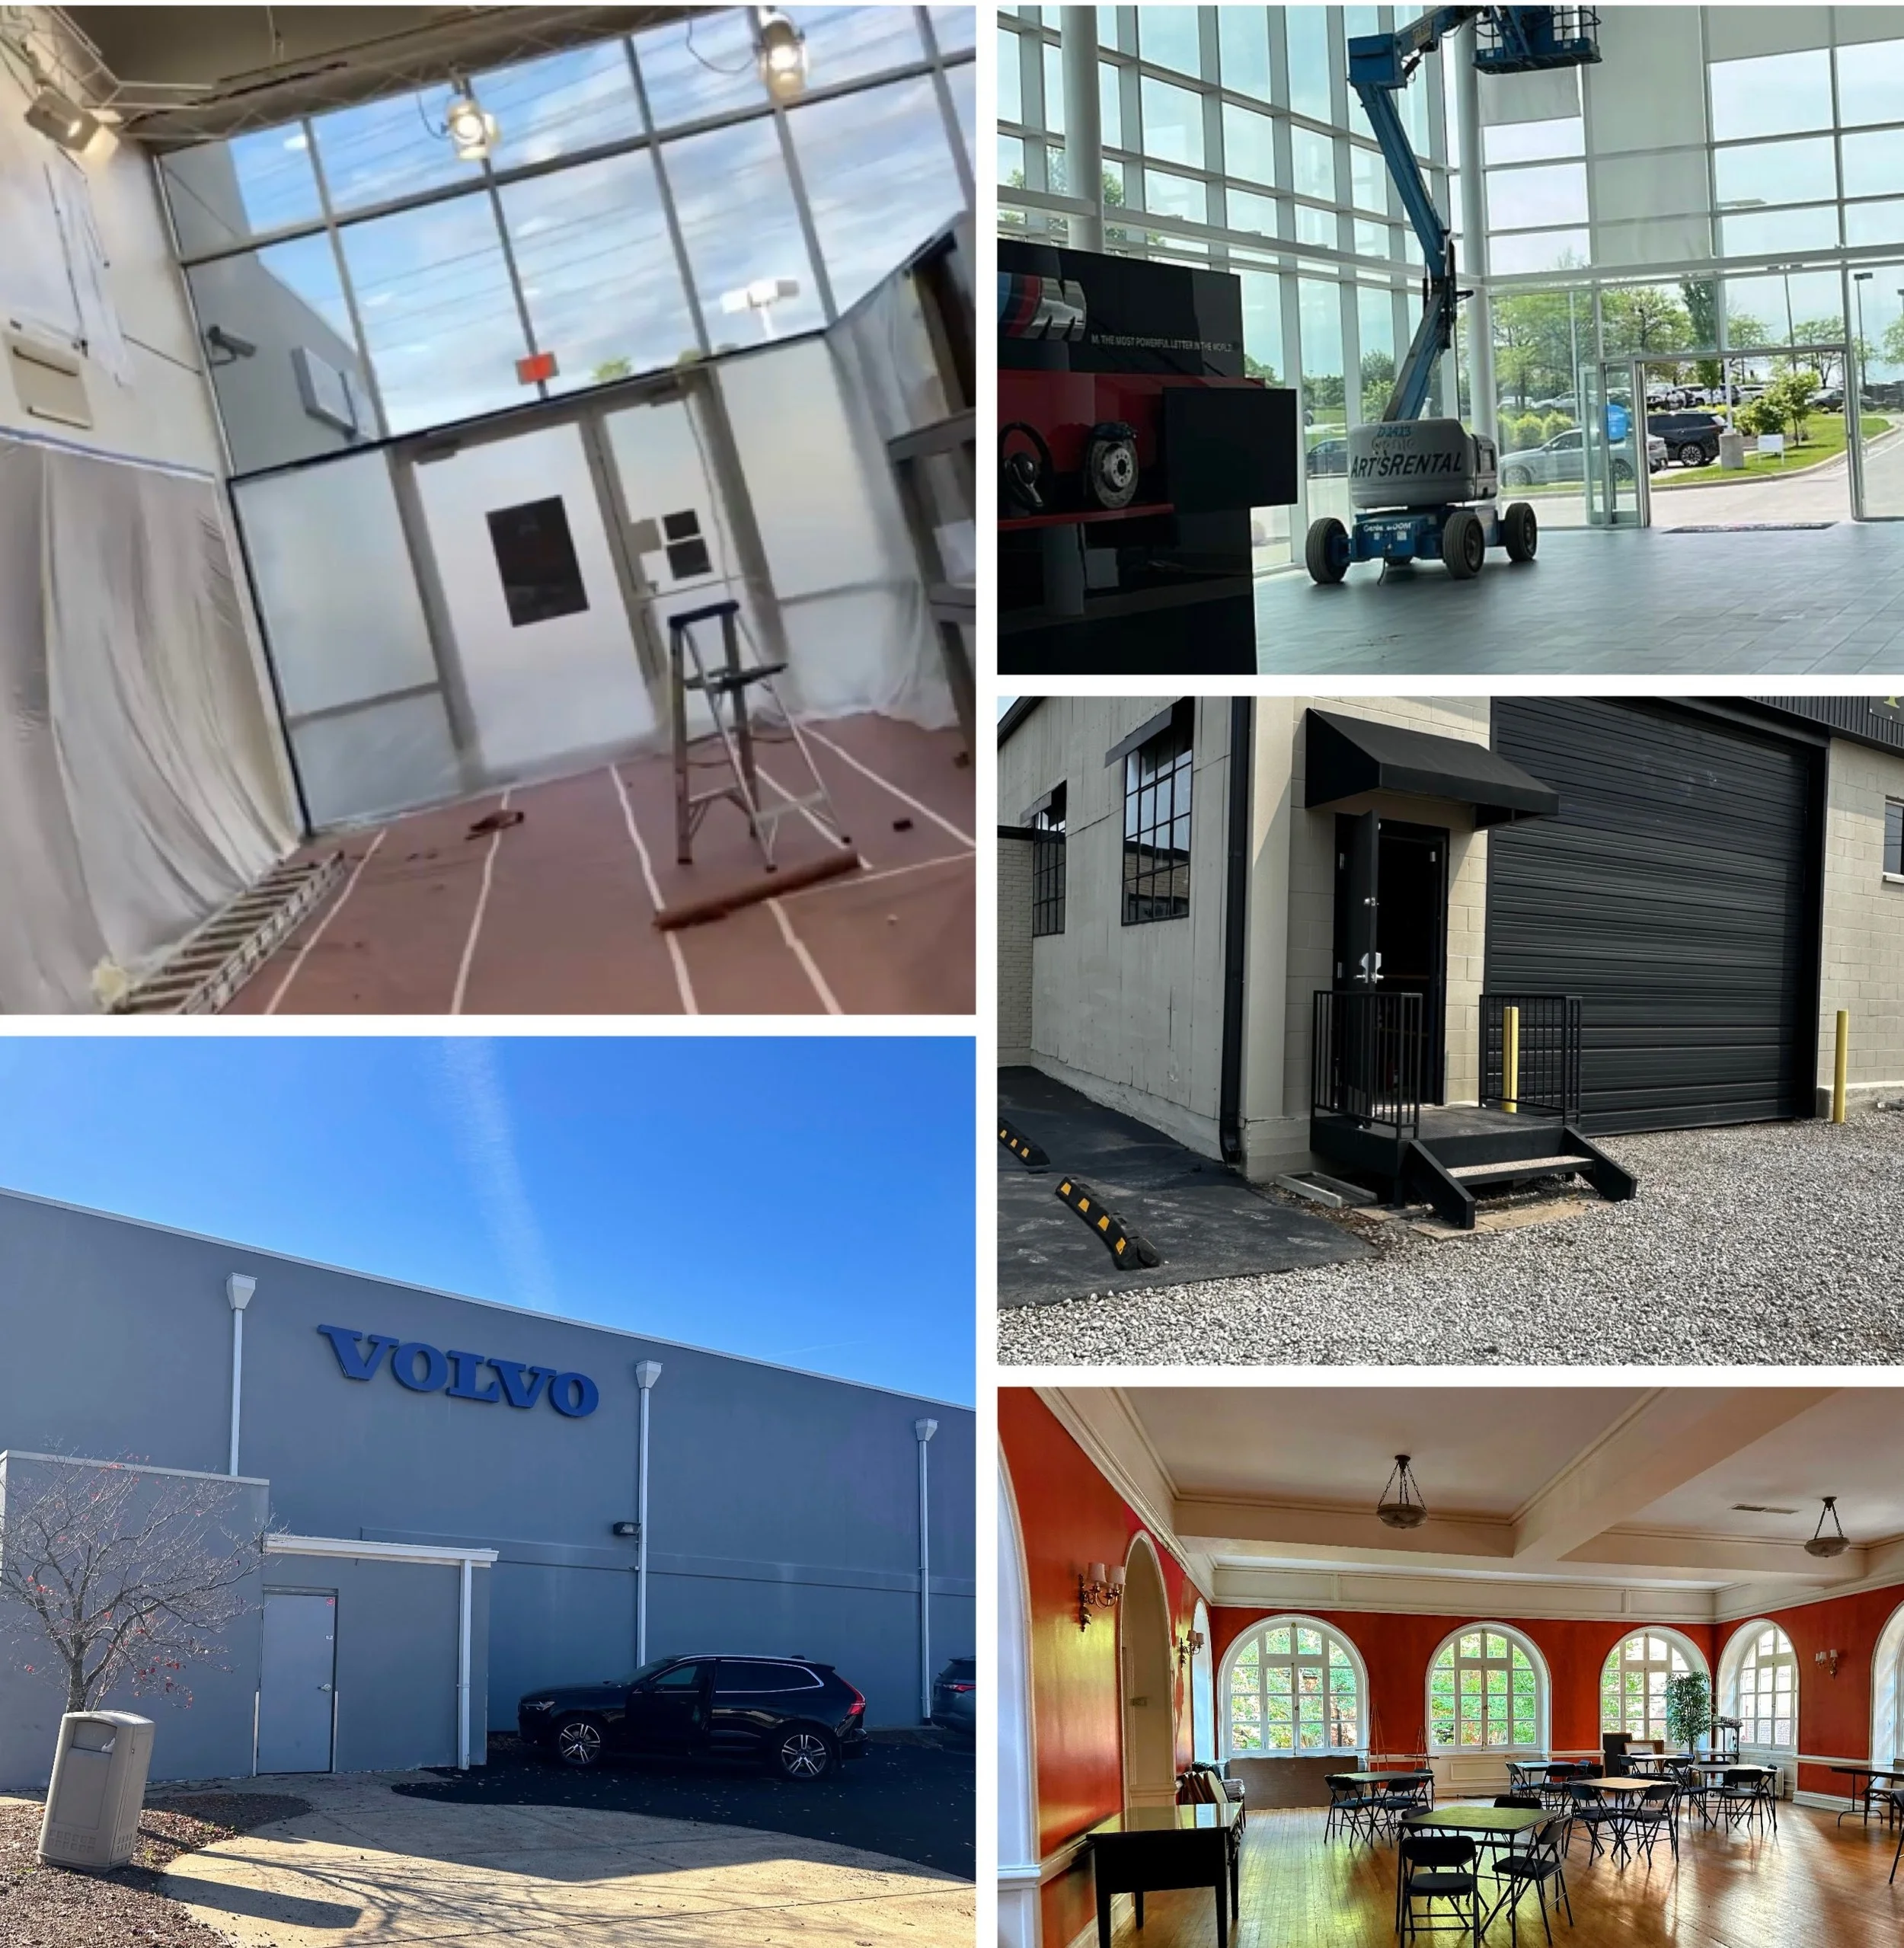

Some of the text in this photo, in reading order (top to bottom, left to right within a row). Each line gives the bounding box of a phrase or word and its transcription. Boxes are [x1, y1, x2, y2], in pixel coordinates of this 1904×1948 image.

[1101, 334, 1115, 345] THE
[1116, 336, 1135, 346] MOST
[1171, 339, 1193, 350] LETTER
[1388, 452, 1462, 476] RENTAL
[317, 1324, 599, 1418] VOLVO
